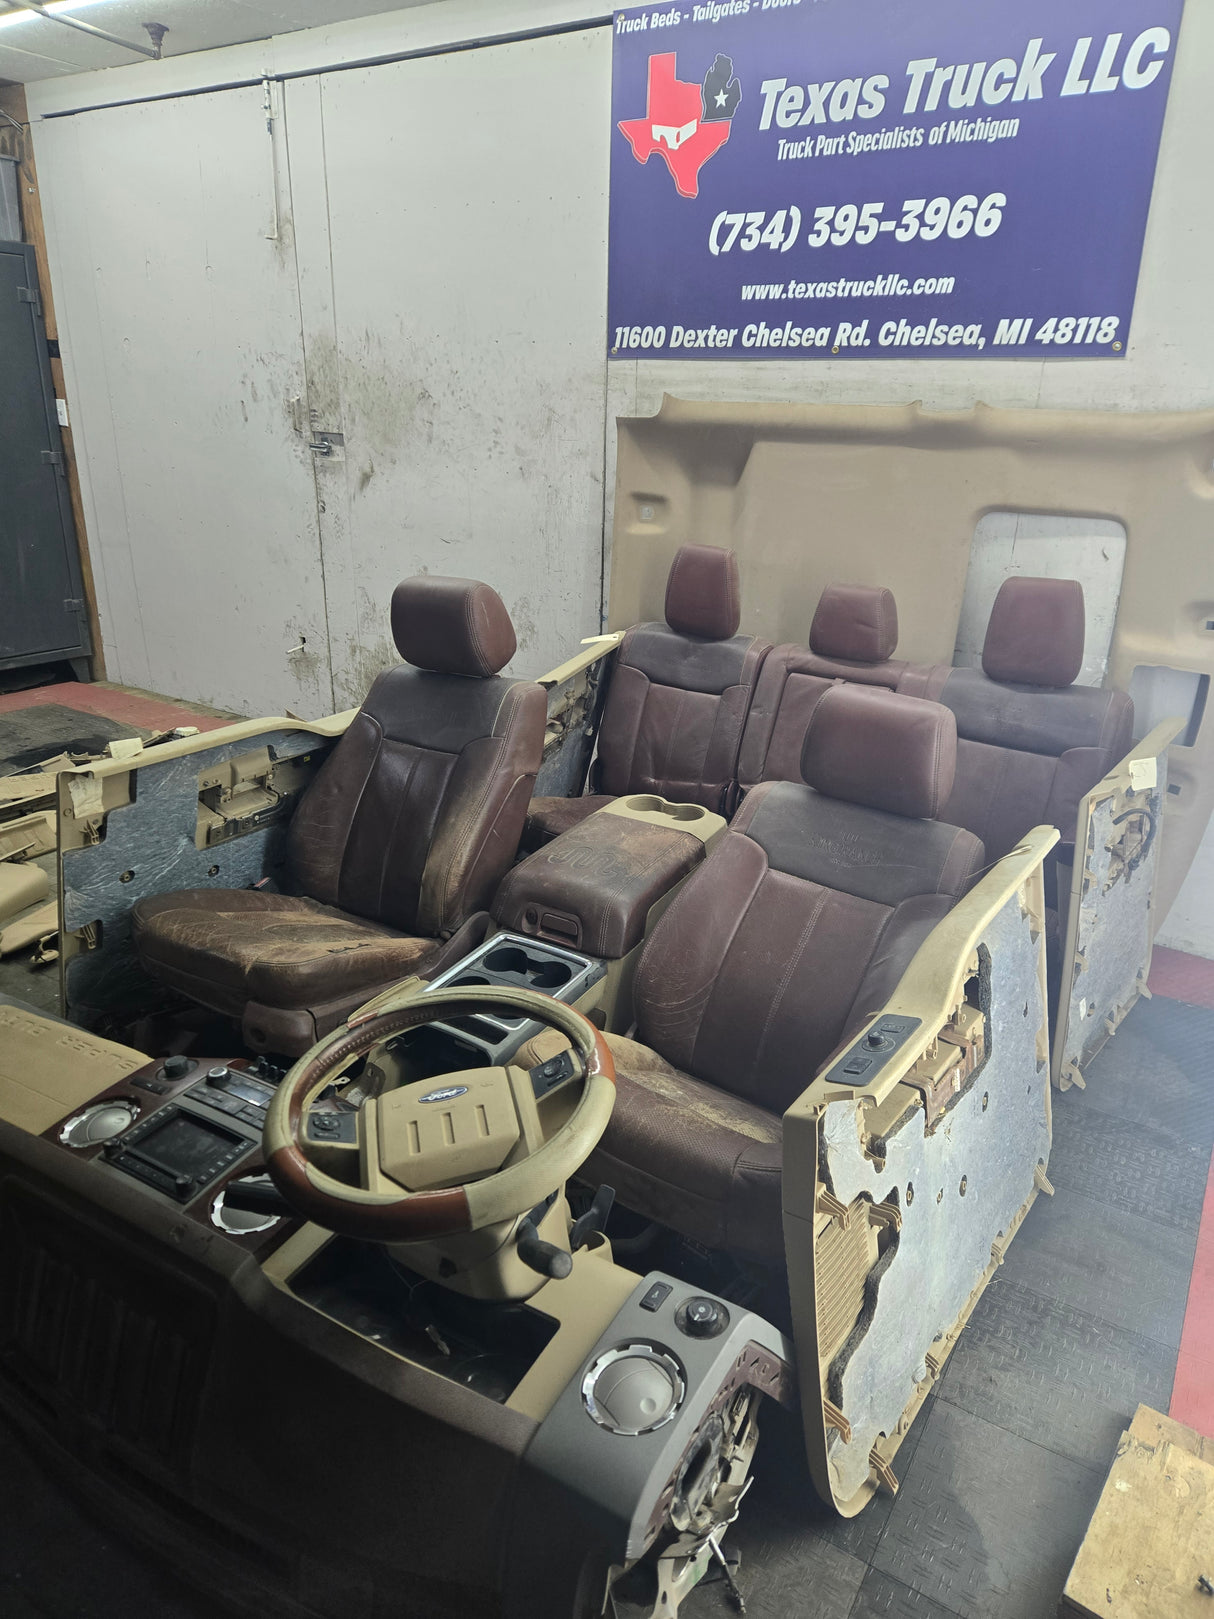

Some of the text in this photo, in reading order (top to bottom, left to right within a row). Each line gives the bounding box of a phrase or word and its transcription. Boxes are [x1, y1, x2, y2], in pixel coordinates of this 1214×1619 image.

[616, 14, 649, 34] Truck
[650, 9, 681, 29] Beds
[692, 0, 751, 24] Tailgates
[759, 27, 1171, 131] Texas Truck LLC
[777, 117, 1020, 161] Truck Part Specialists of Michigan
[709, 192, 1007, 255] (734) 395-3966
[741, 273, 956, 301] www.texastruckllc.com
[613, 315, 1120, 350] 11600 Dexter Chelsea Rd. Chelsea, MI 48118
[422, 1086, 462, 1102] Ford
